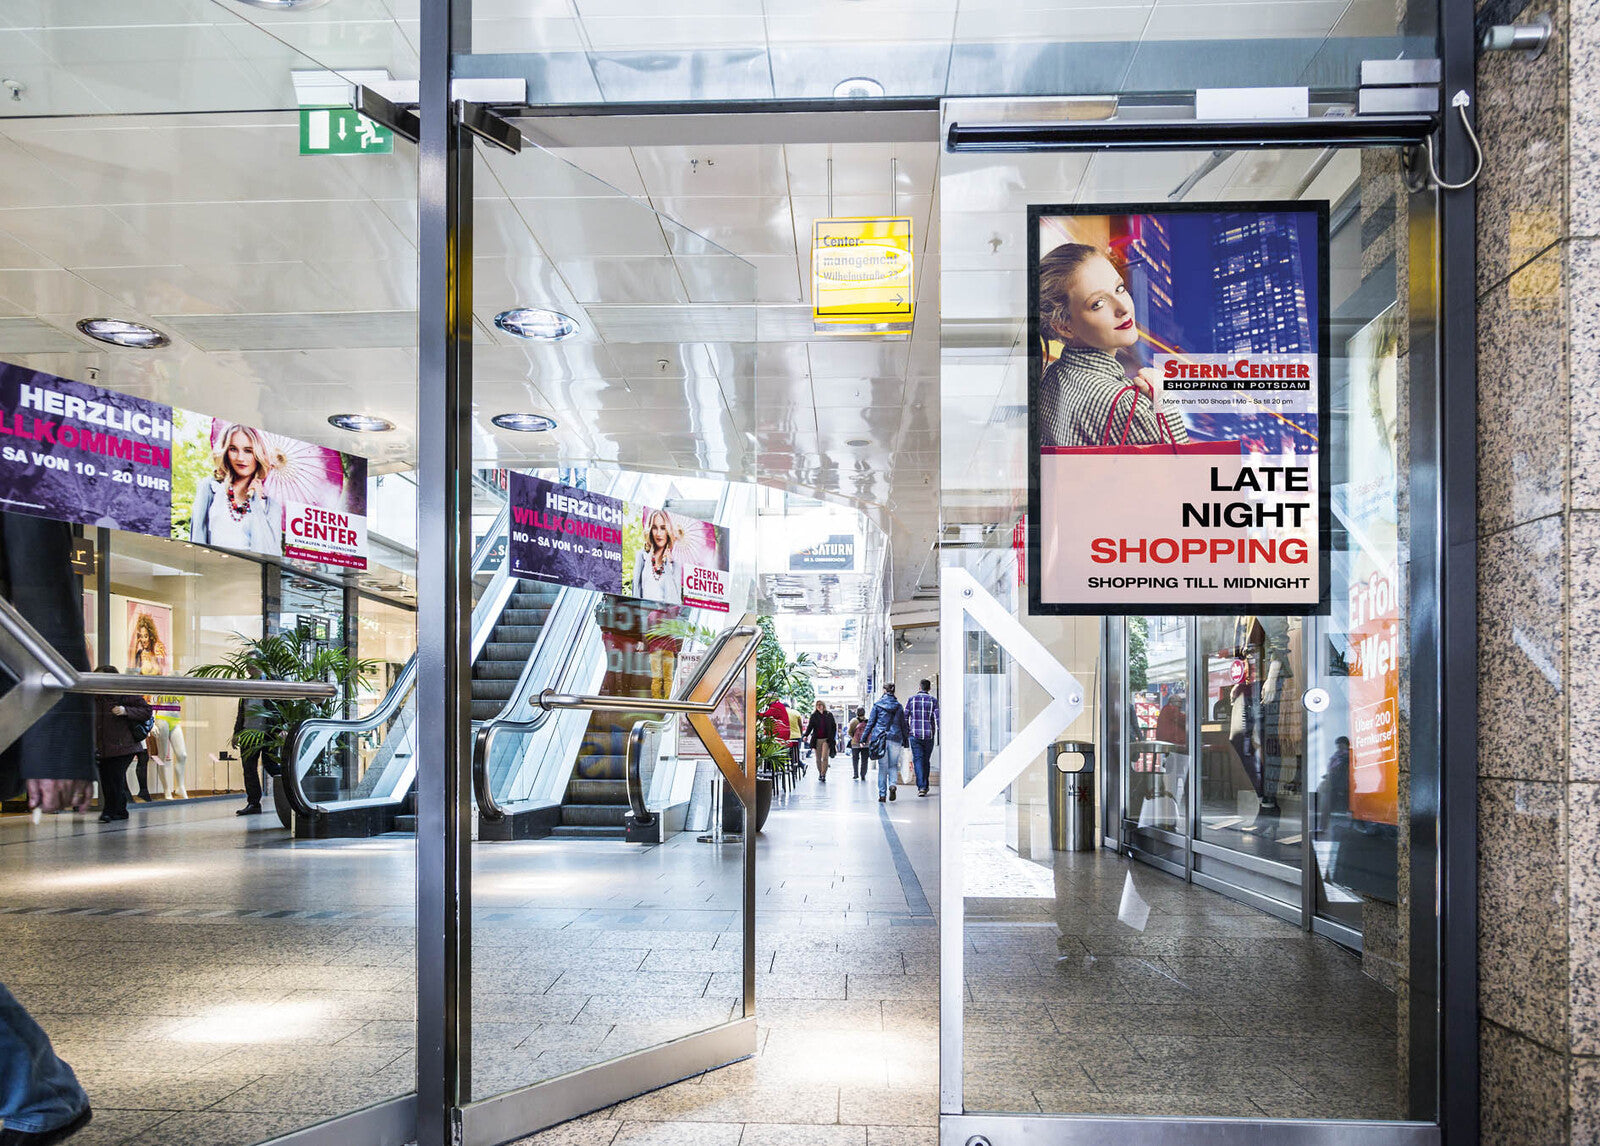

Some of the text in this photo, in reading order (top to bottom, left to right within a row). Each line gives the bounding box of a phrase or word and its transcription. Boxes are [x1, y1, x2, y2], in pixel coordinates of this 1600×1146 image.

[823, 235, 864, 247] Center-
[823, 254, 898, 268] management
[20, 383, 171, 441] HERZLICH
[1210, 398, 1231, 406] Shops
[2, 446, 29, 464] SA
[31, 452, 69, 472] VON
[75, 462, 96, 476] 10
[112, 470, 132, 484] 20
[137, 474, 170, 492] UHR
[1210, 467, 1309, 492] LATE
[304, 507, 348, 528] STERN
[546, 492, 622, 524] HERZLICH
[1182, 502, 1310, 528] NIGHT
[290, 517, 358, 547] CENTER
[513, 505, 622, 545] WILLKOMMEN
[513, 531, 529, 543] MO
[538, 536, 551, 548] SA
[552, 540, 571, 551] VON
[573, 544, 583, 554] 10
[592, 548, 602, 558] 20
[604, 550, 622, 561] UHR
[811, 543, 853, 556] SATURN
[1090, 538, 1308, 564] SHOPPING
[686, 575, 724, 595] CENTER
[693, 567, 719, 581] STERN
[1087, 577, 1310, 589] SHOPPING TILL MIDNIGHT
[1375, 711, 1391, 727] 200
